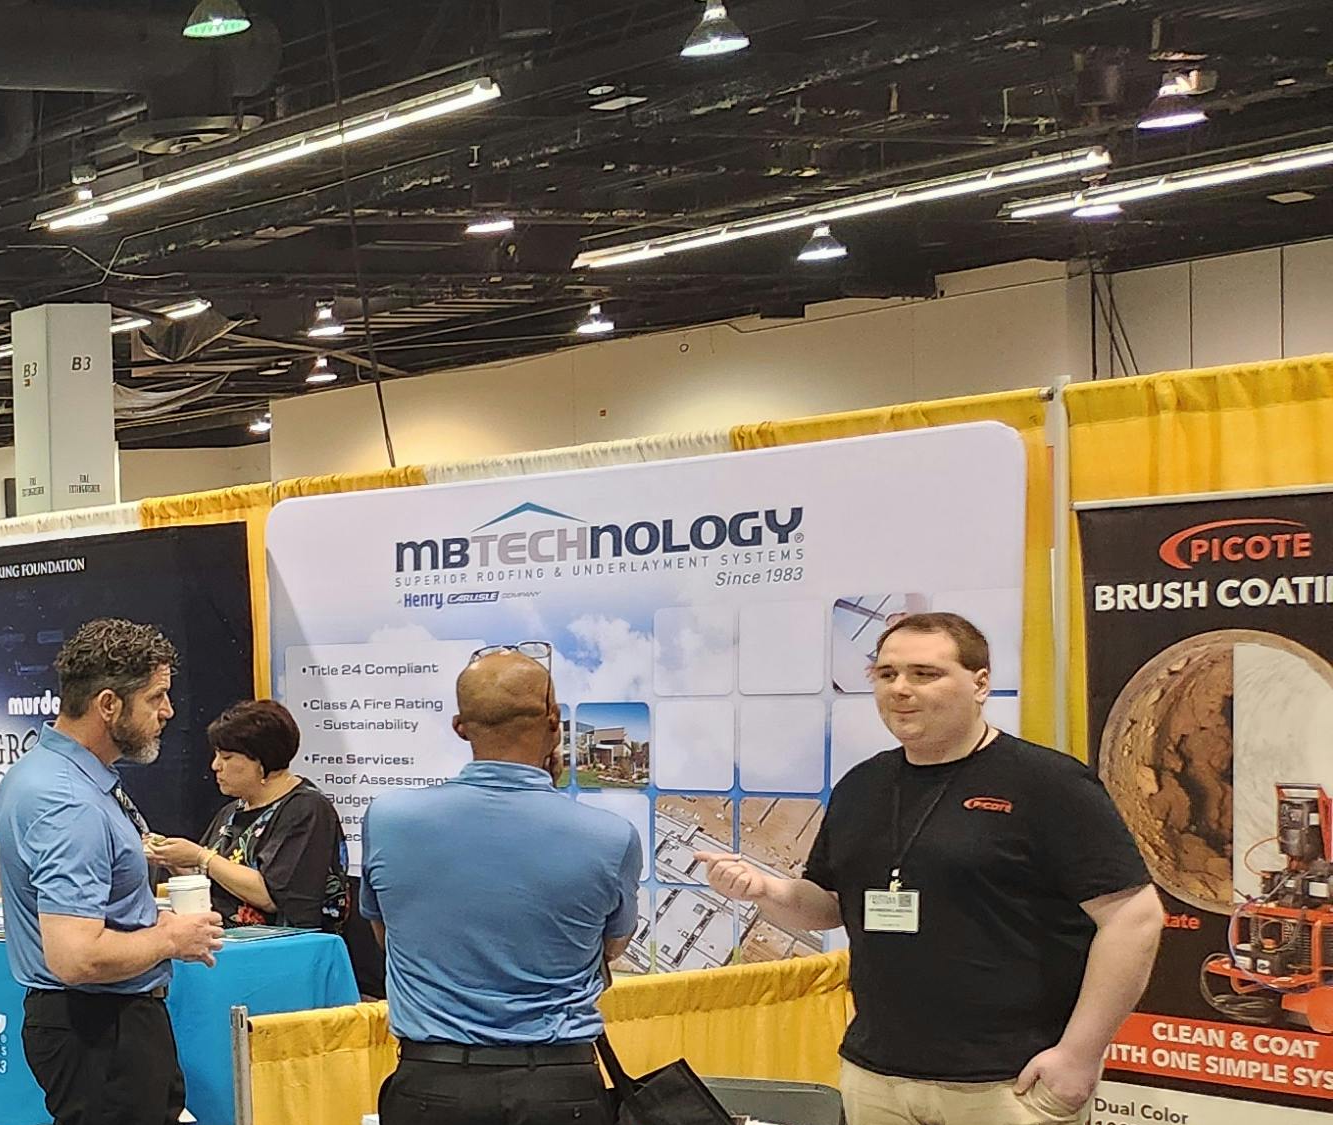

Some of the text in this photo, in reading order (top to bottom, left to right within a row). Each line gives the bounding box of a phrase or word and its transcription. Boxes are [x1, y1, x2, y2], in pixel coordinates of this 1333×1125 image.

[23, 362, 38, 378] B3
[72, 356, 92, 371] B3
[1190, 532, 1312, 563] PICOTE
[21, 557, 86, 578] FOUNDATION
[395, 547, 805, 588] SUPERIOR ROOFING & UNDERLAYMENT SYSTEMS
[716, 566, 804, 588] Since 1983
[403, 592, 444, 610] Henry
[1094, 575, 1333, 611] BRUSH COATI
[308, 663, 439, 677] Title 24 Compliant
[310, 698, 444, 712] Class A Fire Rating
[323, 719, 419, 733] Sustainability
[311, 753, 415, 765] Free Services:
[324, 774, 358, 785] Roof
[1152, 1021, 1320, 1060] CLEAN & COAT
[1151, 1049, 1201, 1072] ONE
[1205, 1056, 1288, 1084] SIMPLE
[1292, 1066, 1333, 1091] SYS
[1094, 1097, 1189, 1125] Dual Color
